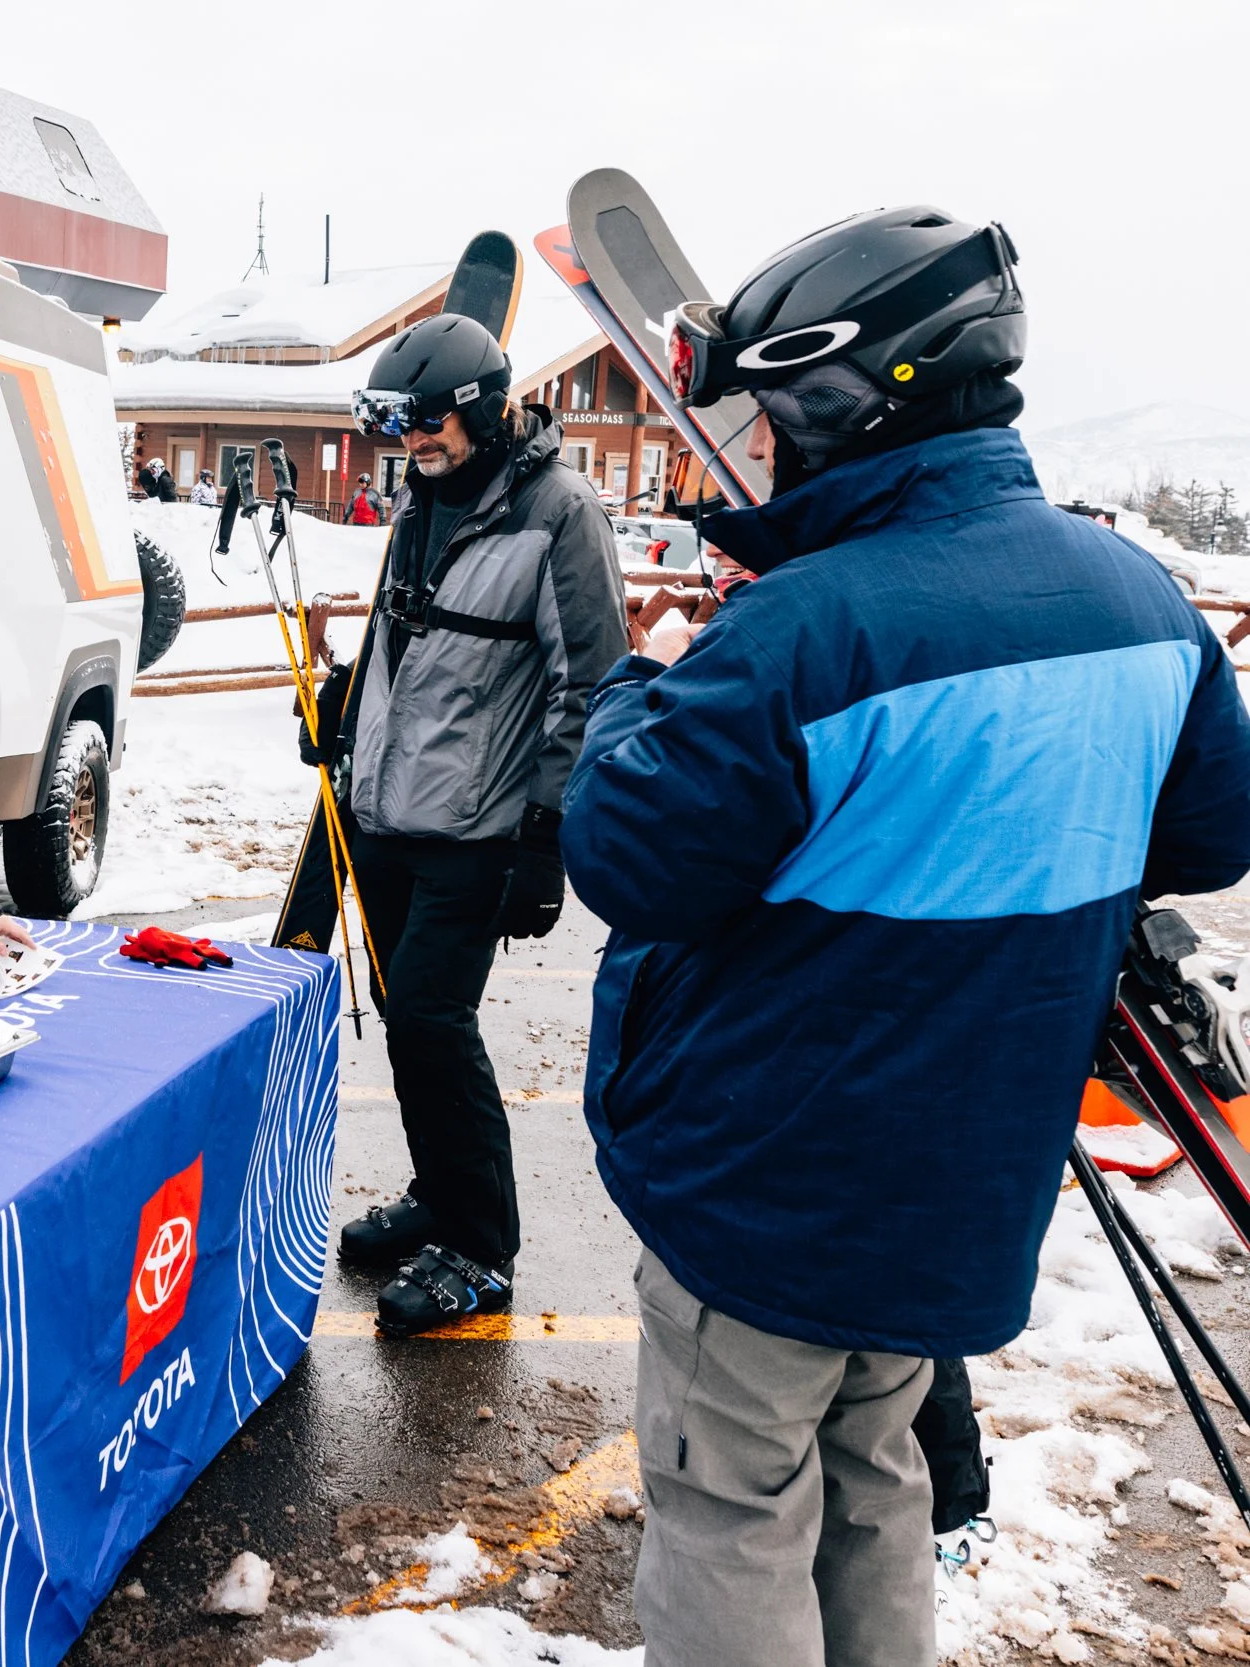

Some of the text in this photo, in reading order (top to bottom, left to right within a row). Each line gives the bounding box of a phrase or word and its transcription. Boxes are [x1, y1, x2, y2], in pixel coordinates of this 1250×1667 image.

[562, 412, 600, 424] SEASON
[601, 414, 624, 425] PASS
[99, 1346, 196, 1493] TOYOTA
